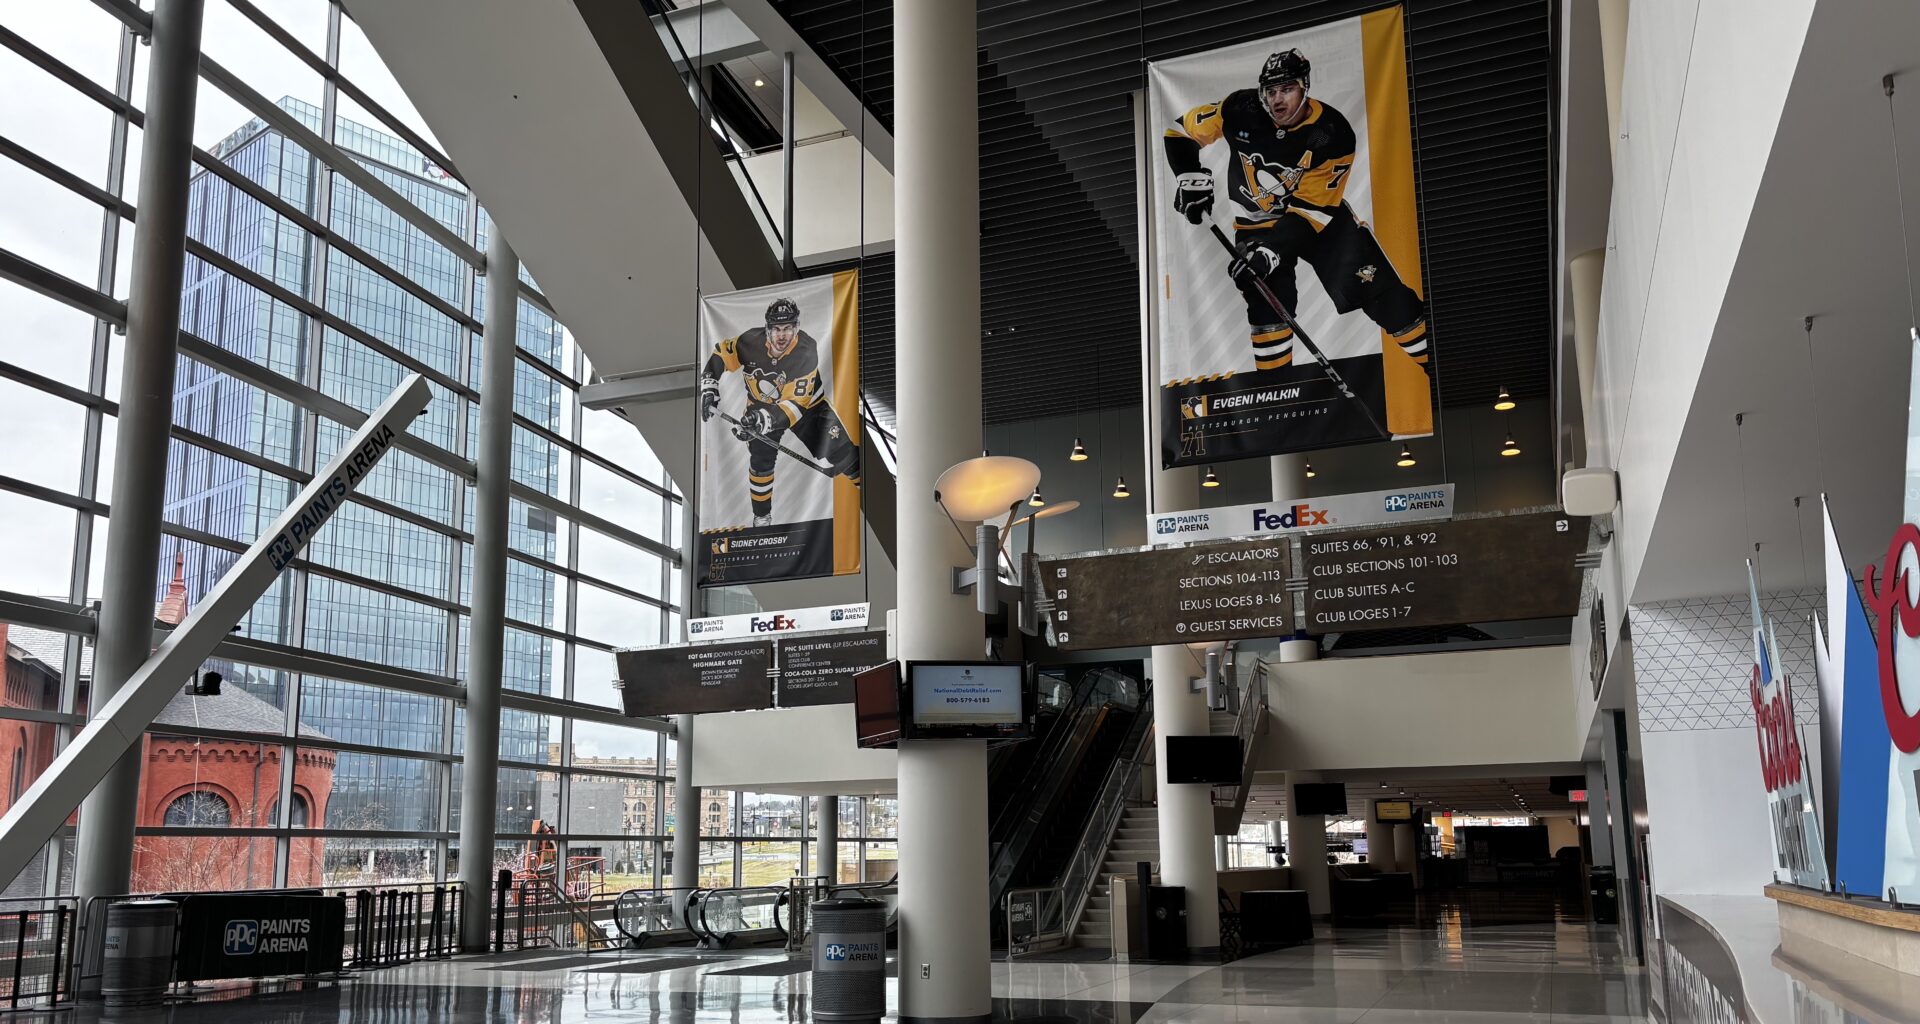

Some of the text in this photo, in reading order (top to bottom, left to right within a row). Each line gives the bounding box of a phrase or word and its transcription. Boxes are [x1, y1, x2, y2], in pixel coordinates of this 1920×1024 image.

[1297, 150, 1312, 168] A
[1180, 179, 1214, 188] CCM
[1212, 388, 1300, 410] EVGENI MALKIN
[1188, 407, 1328, 432] PITTSBURGH PENGUINS
[1181, 430, 1206, 457] 71
[268, 424, 395, 569] PPG PAINTS ARENA
[1408, 490, 1444, 500] PAINTS
[1384, 496, 1407, 511] PPG
[1409, 500, 1444, 510] ARENA
[1178, 514, 1210, 524] PAINTS
[1253, 503, 1328, 531] FedEx
[1157, 519, 1176, 533] PPG
[1178, 523, 1210, 533] ARENA
[730, 536, 788, 548] SIDNEY CROSBY
[1311, 541, 1349, 554] SUITES
[1353, 540, 1372, 551] 66,
[1404, 535, 1413, 546] &
[1208, 548, 1279, 564] ESCALATORS
[709, 563, 726, 580] 87
[1313, 554, 1458, 576] CLUB SECTIONS 101-103
[1180, 570, 1280, 588] SECTIONS 104-113
[1314, 582, 1415, 600] CLUB SUITES A-C
[1180, 598, 1212, 610] LEXUS
[1216, 595, 1252, 608] LOGES
[830, 608, 844, 621] PPG
[1316, 606, 1411, 623] CLUB LOGES 1-7
[691, 622, 703, 634] PPG
[751, 615, 796, 632] FedEx
[1190, 616, 1282, 632] GUEST SERVICES
[842, 639, 878, 647] ESCALATORS)
[260, 919, 310, 934] PAINTS
[224, 922, 257, 952] PPG
[258, 937, 308, 953] ARENA
[826, 944, 845, 960] PPG
